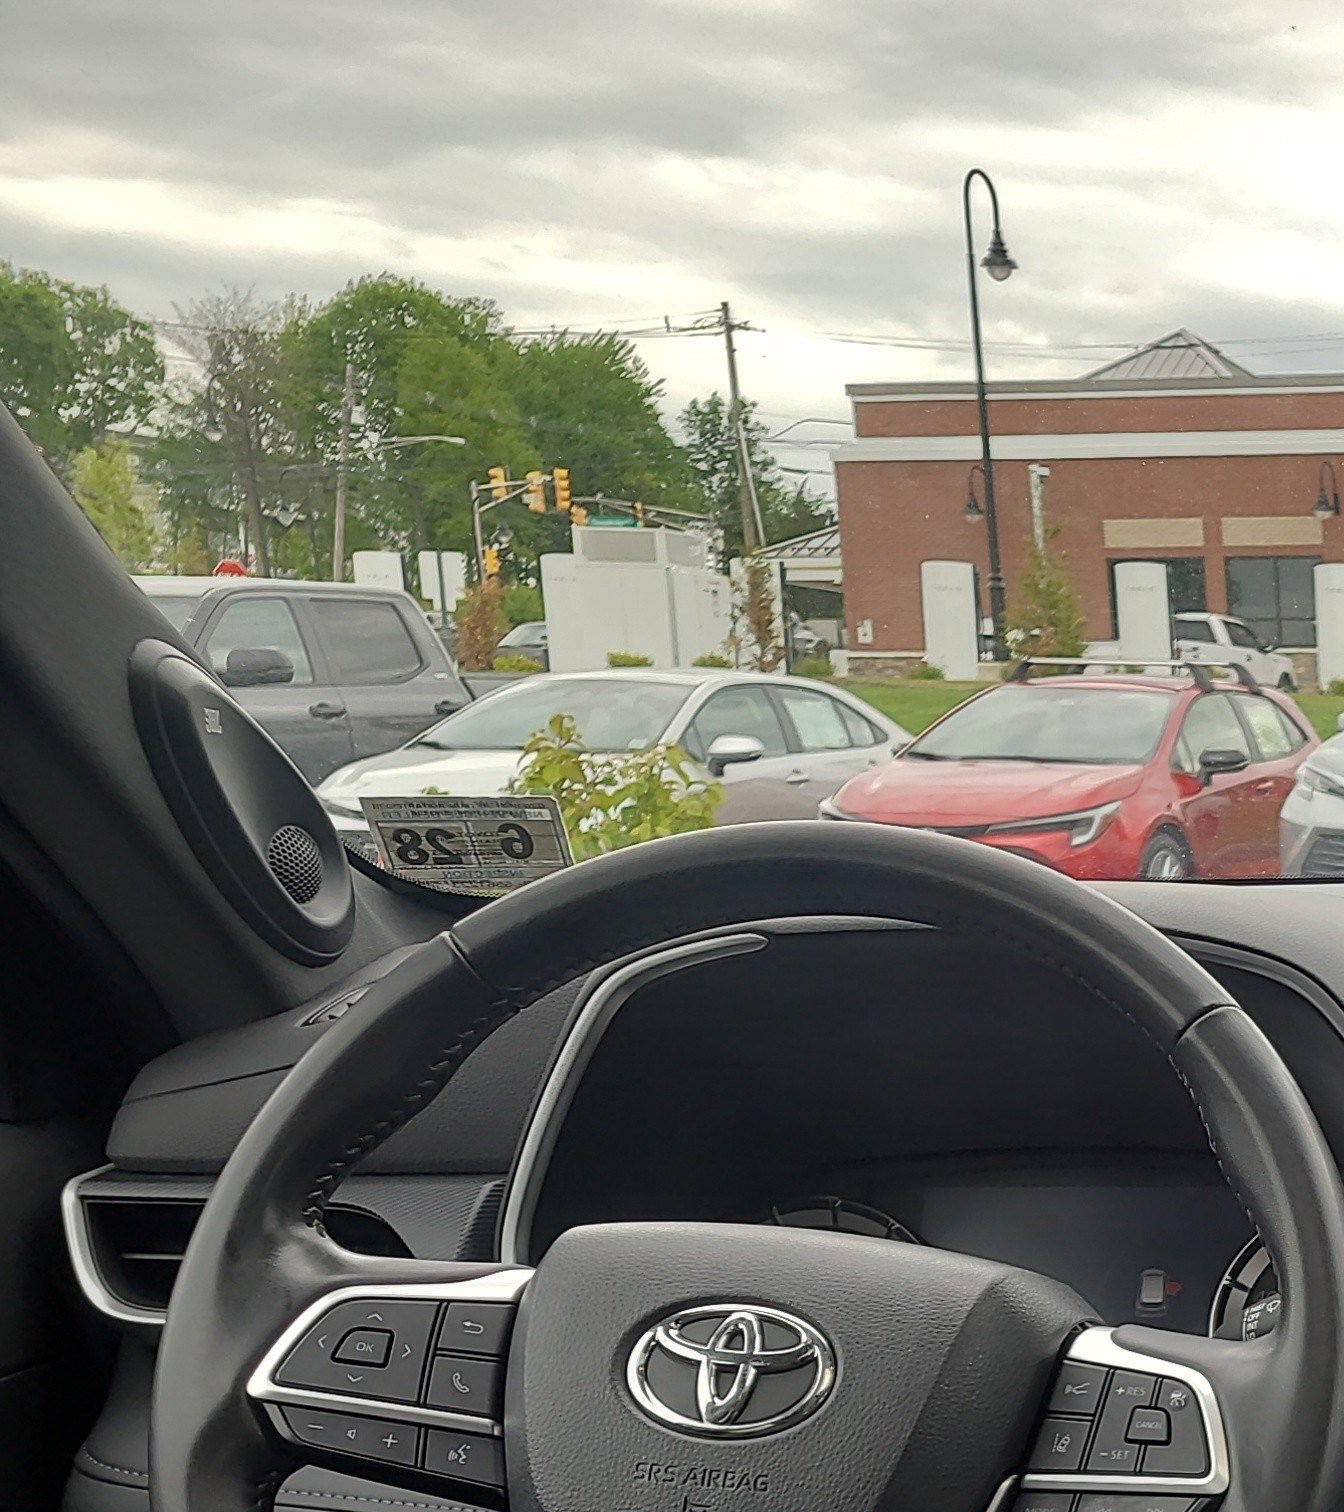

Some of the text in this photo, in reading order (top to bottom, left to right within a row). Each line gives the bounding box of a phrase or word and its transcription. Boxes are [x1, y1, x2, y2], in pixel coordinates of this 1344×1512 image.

[356, 1341, 374, 1353] OK
[1135, 1420, 1162, 1430] CANCEL
[633, 1462, 770, 1493] SRS AIRBAG
